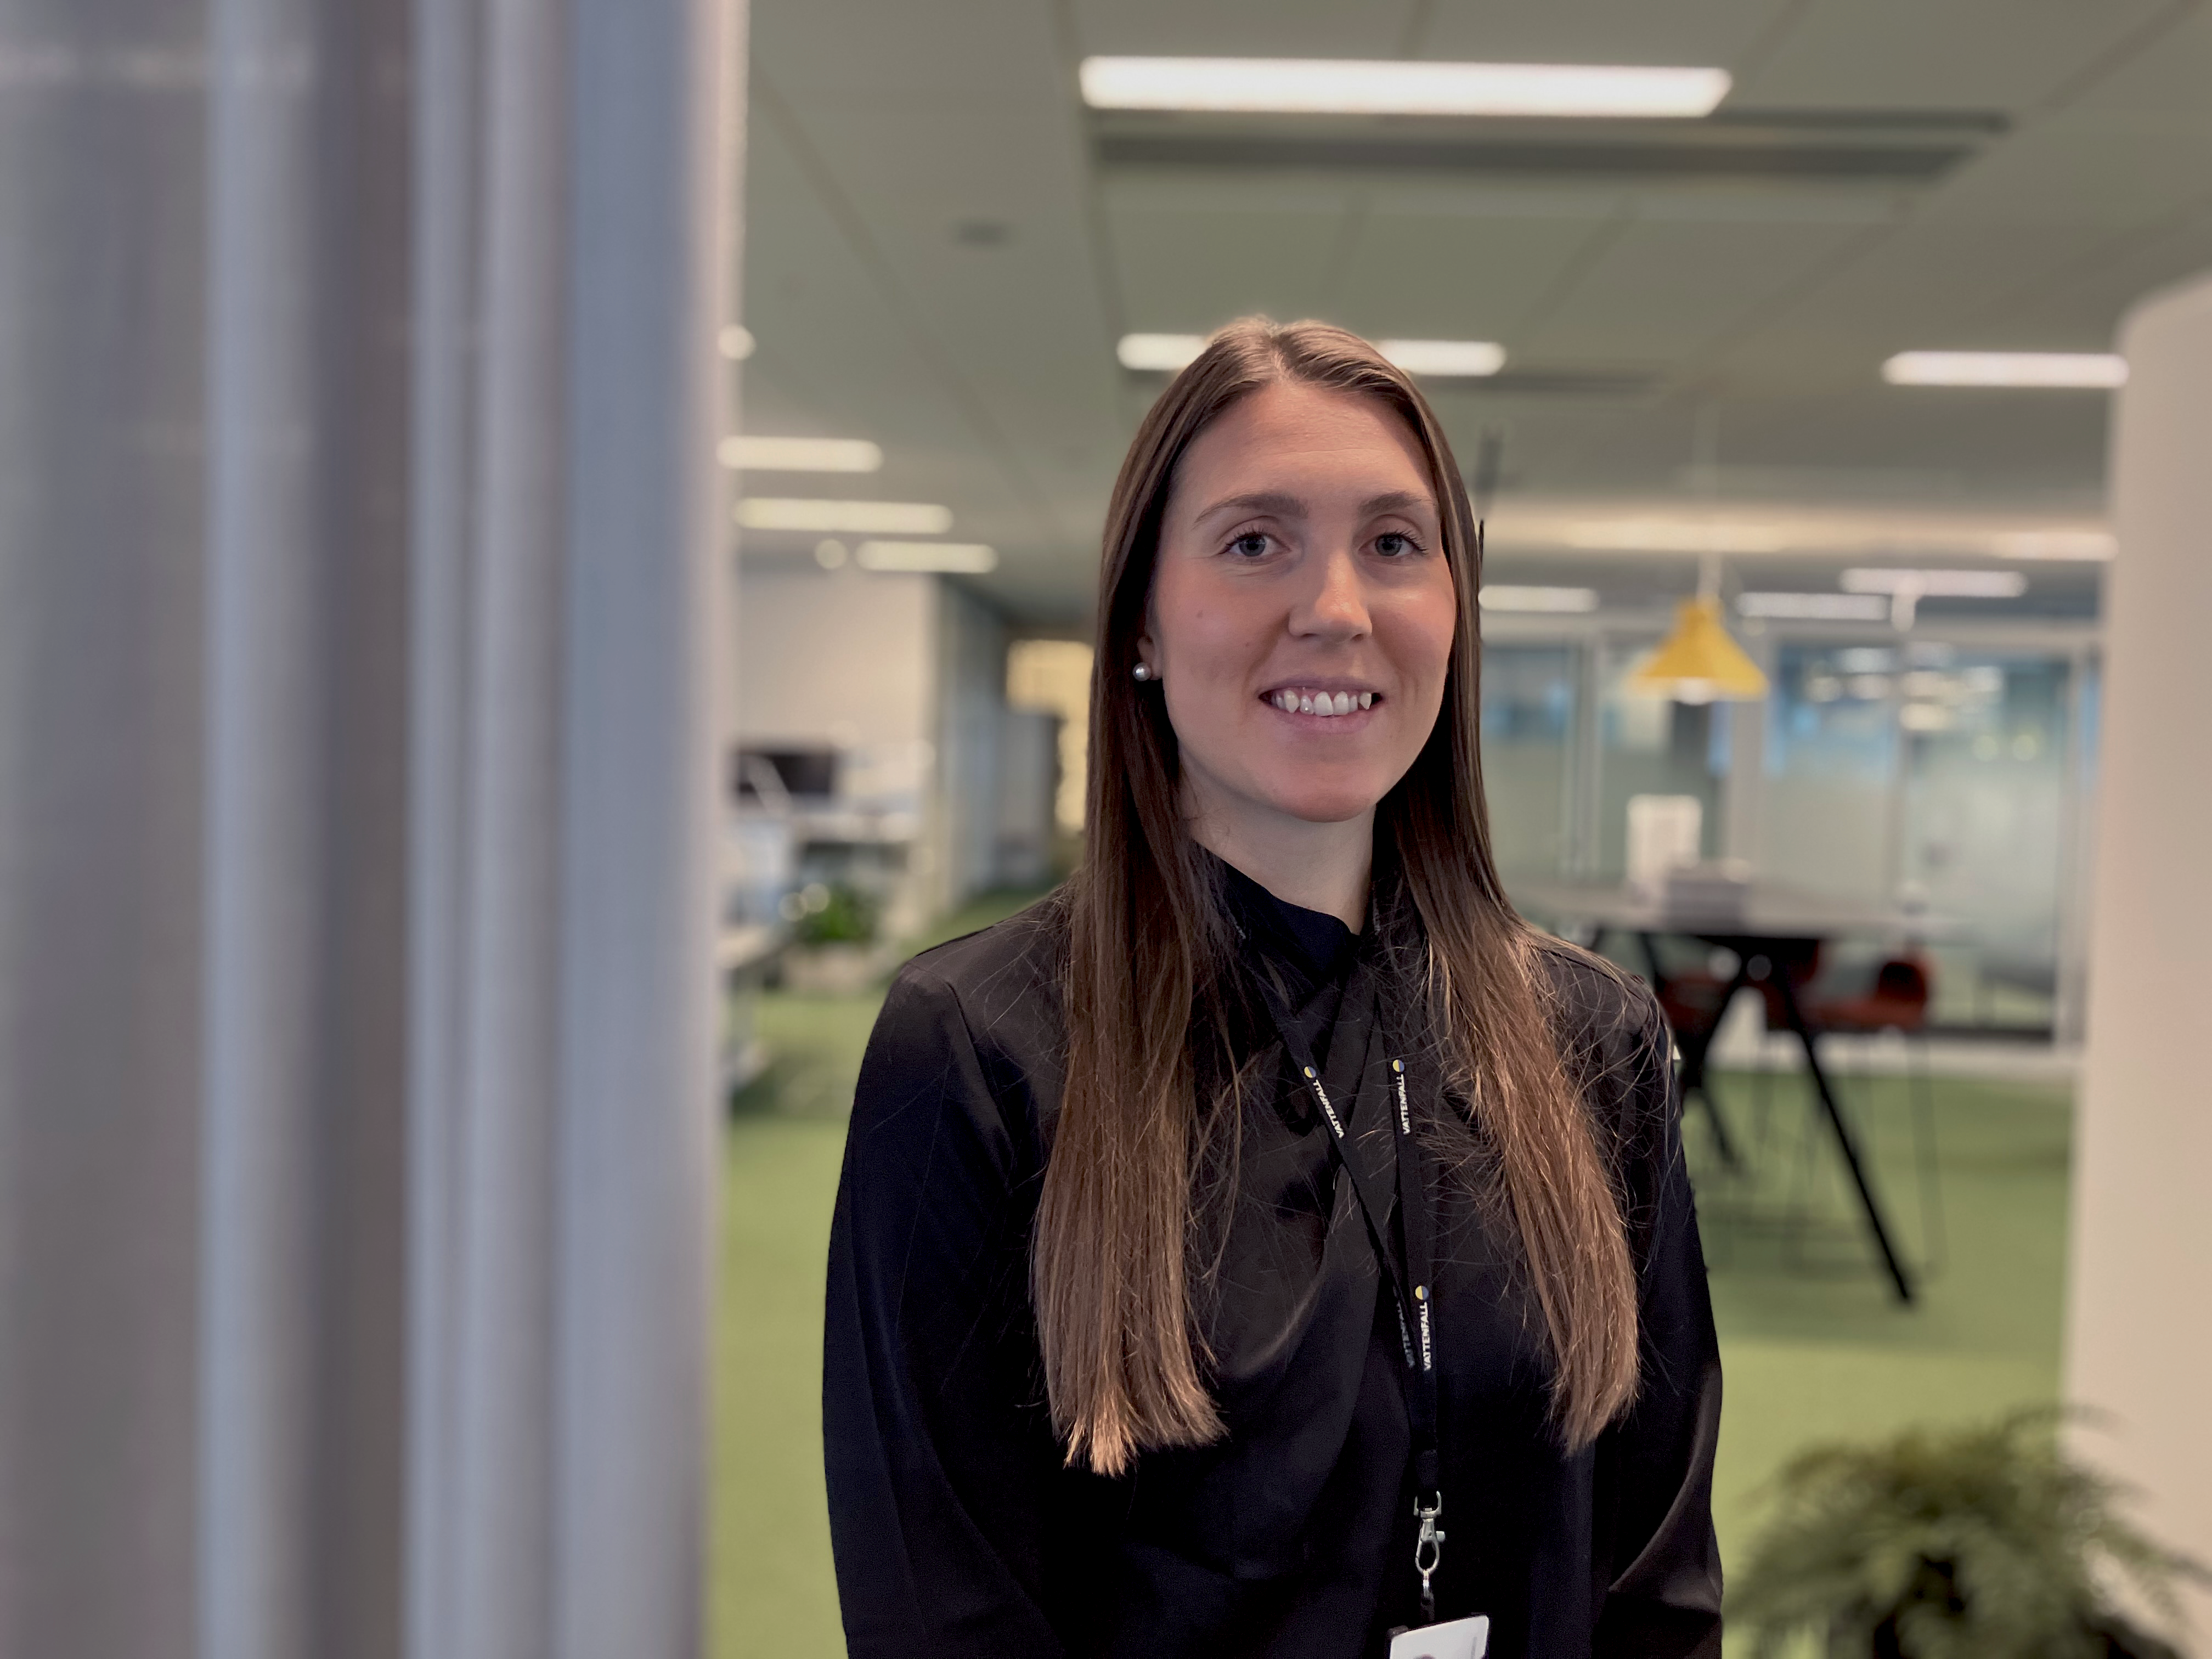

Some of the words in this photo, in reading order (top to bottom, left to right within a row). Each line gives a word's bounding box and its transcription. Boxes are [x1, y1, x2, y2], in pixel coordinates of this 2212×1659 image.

[1313, 1079, 1344, 1138] VATTENFALL
[1397, 1074, 1410, 1135] VATTENFALL
[1420, 1302, 1431, 1371] VATTENFALL
